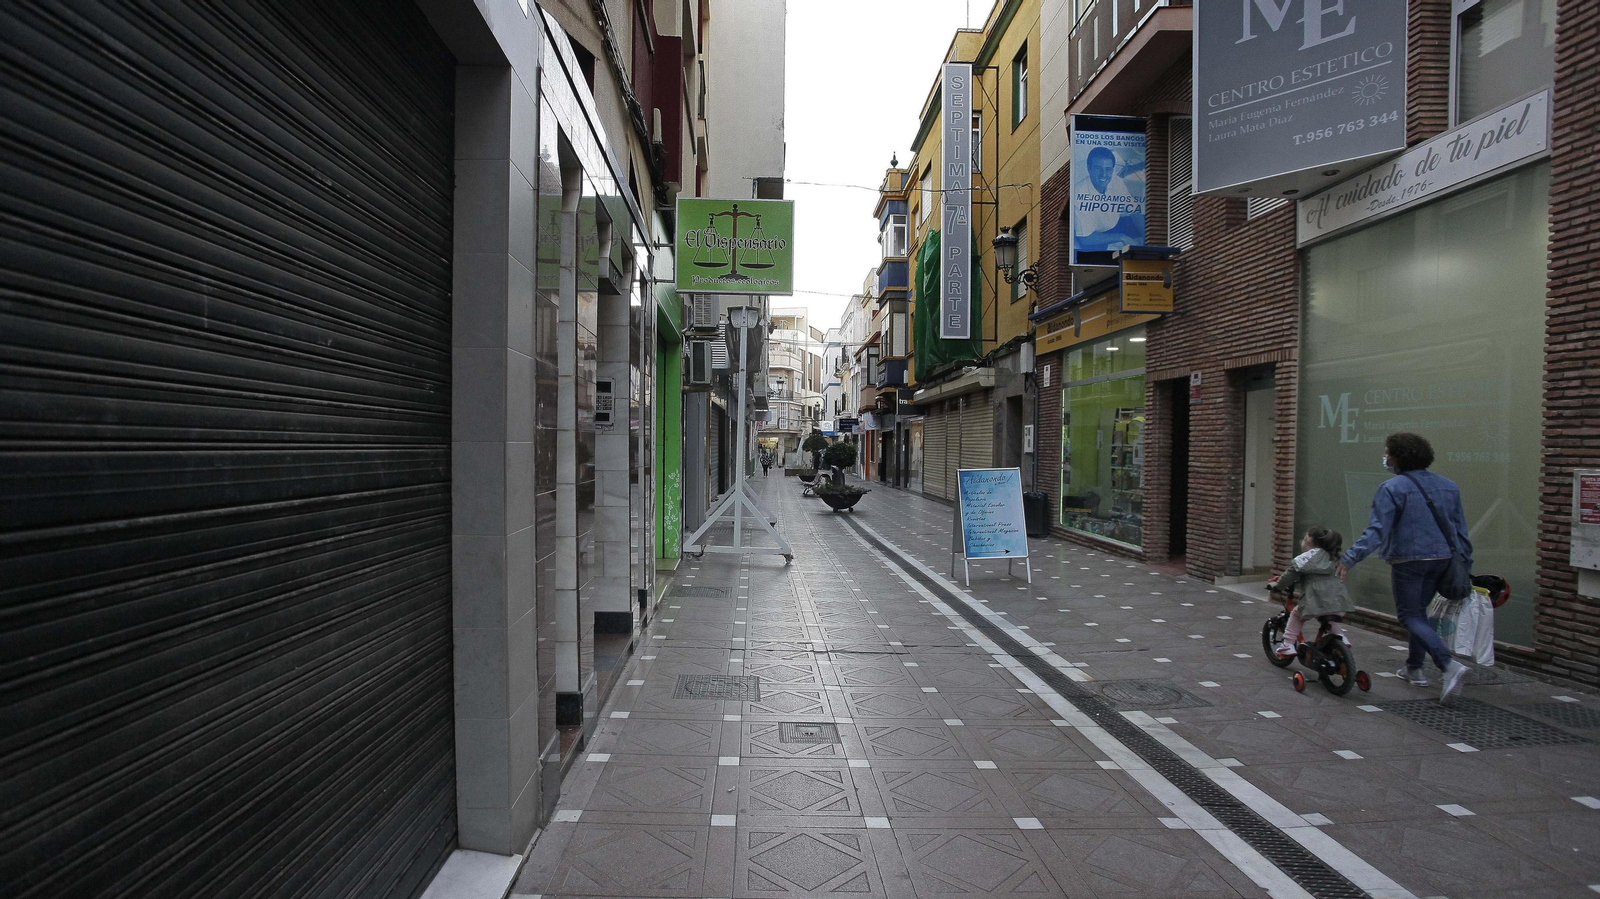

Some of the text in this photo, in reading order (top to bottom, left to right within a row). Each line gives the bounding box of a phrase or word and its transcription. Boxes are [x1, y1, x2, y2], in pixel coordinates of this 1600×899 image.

[1208, 41, 1394, 108] CENTRO ESTETICO
[1240, 103, 1282, 120] Eugenia
[949, 75, 966, 196] SEPTIMA
[1208, 129, 1236, 142] Laura
[1239, 122, 1266, 134] Mata
[1292, 109, 1399, 146] T.956 763 344
[1306, 102, 1531, 230] Al cuidado de tu piel
[1076, 193, 1132, 203] MEJORAMOS
[1079, 201, 1142, 214] HIPOTECA
[684, 229, 787, 256] El Dispensario
[692, 275, 734, 286] Productos
[948, 245, 963, 330] PARTE
[1364, 386, 1422, 405] CENTRO
[1317, 392, 1359, 444] ME
